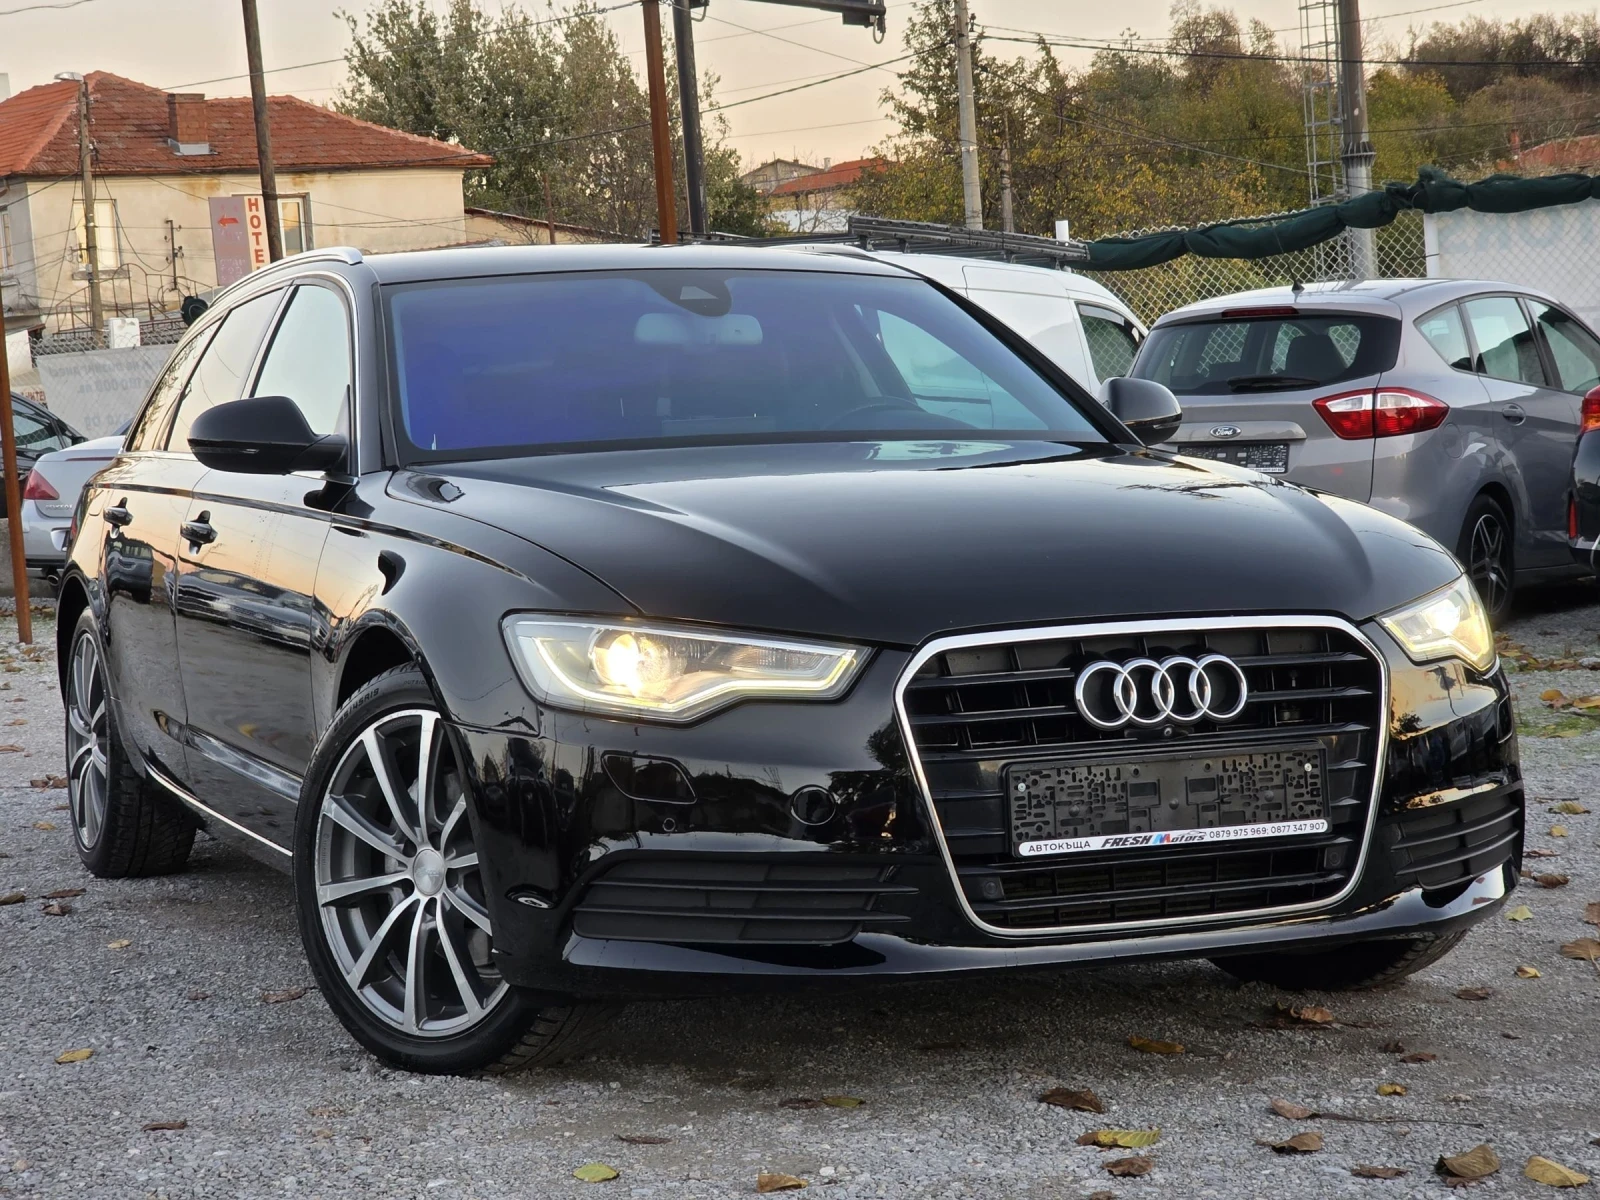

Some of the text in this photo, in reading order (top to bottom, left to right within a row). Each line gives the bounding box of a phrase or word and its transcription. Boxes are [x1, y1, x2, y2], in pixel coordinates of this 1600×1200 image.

[248, 198, 265, 270] HOTE
[1215, 427, 1233, 436] Ford
[1101, 835, 1153, 848] FRESH
[1209, 829, 1231, 839] 0879
[1233, 827, 1249, 837] 975
[1250, 826, 1269, 835] 969;
[1271, 824, 1291, 834] 0877
[1293, 823, 1308, 832] 347
[1309, 822, 1325, 832] 907
[1028, 840, 1091, 853] АВТОКЪЩА
